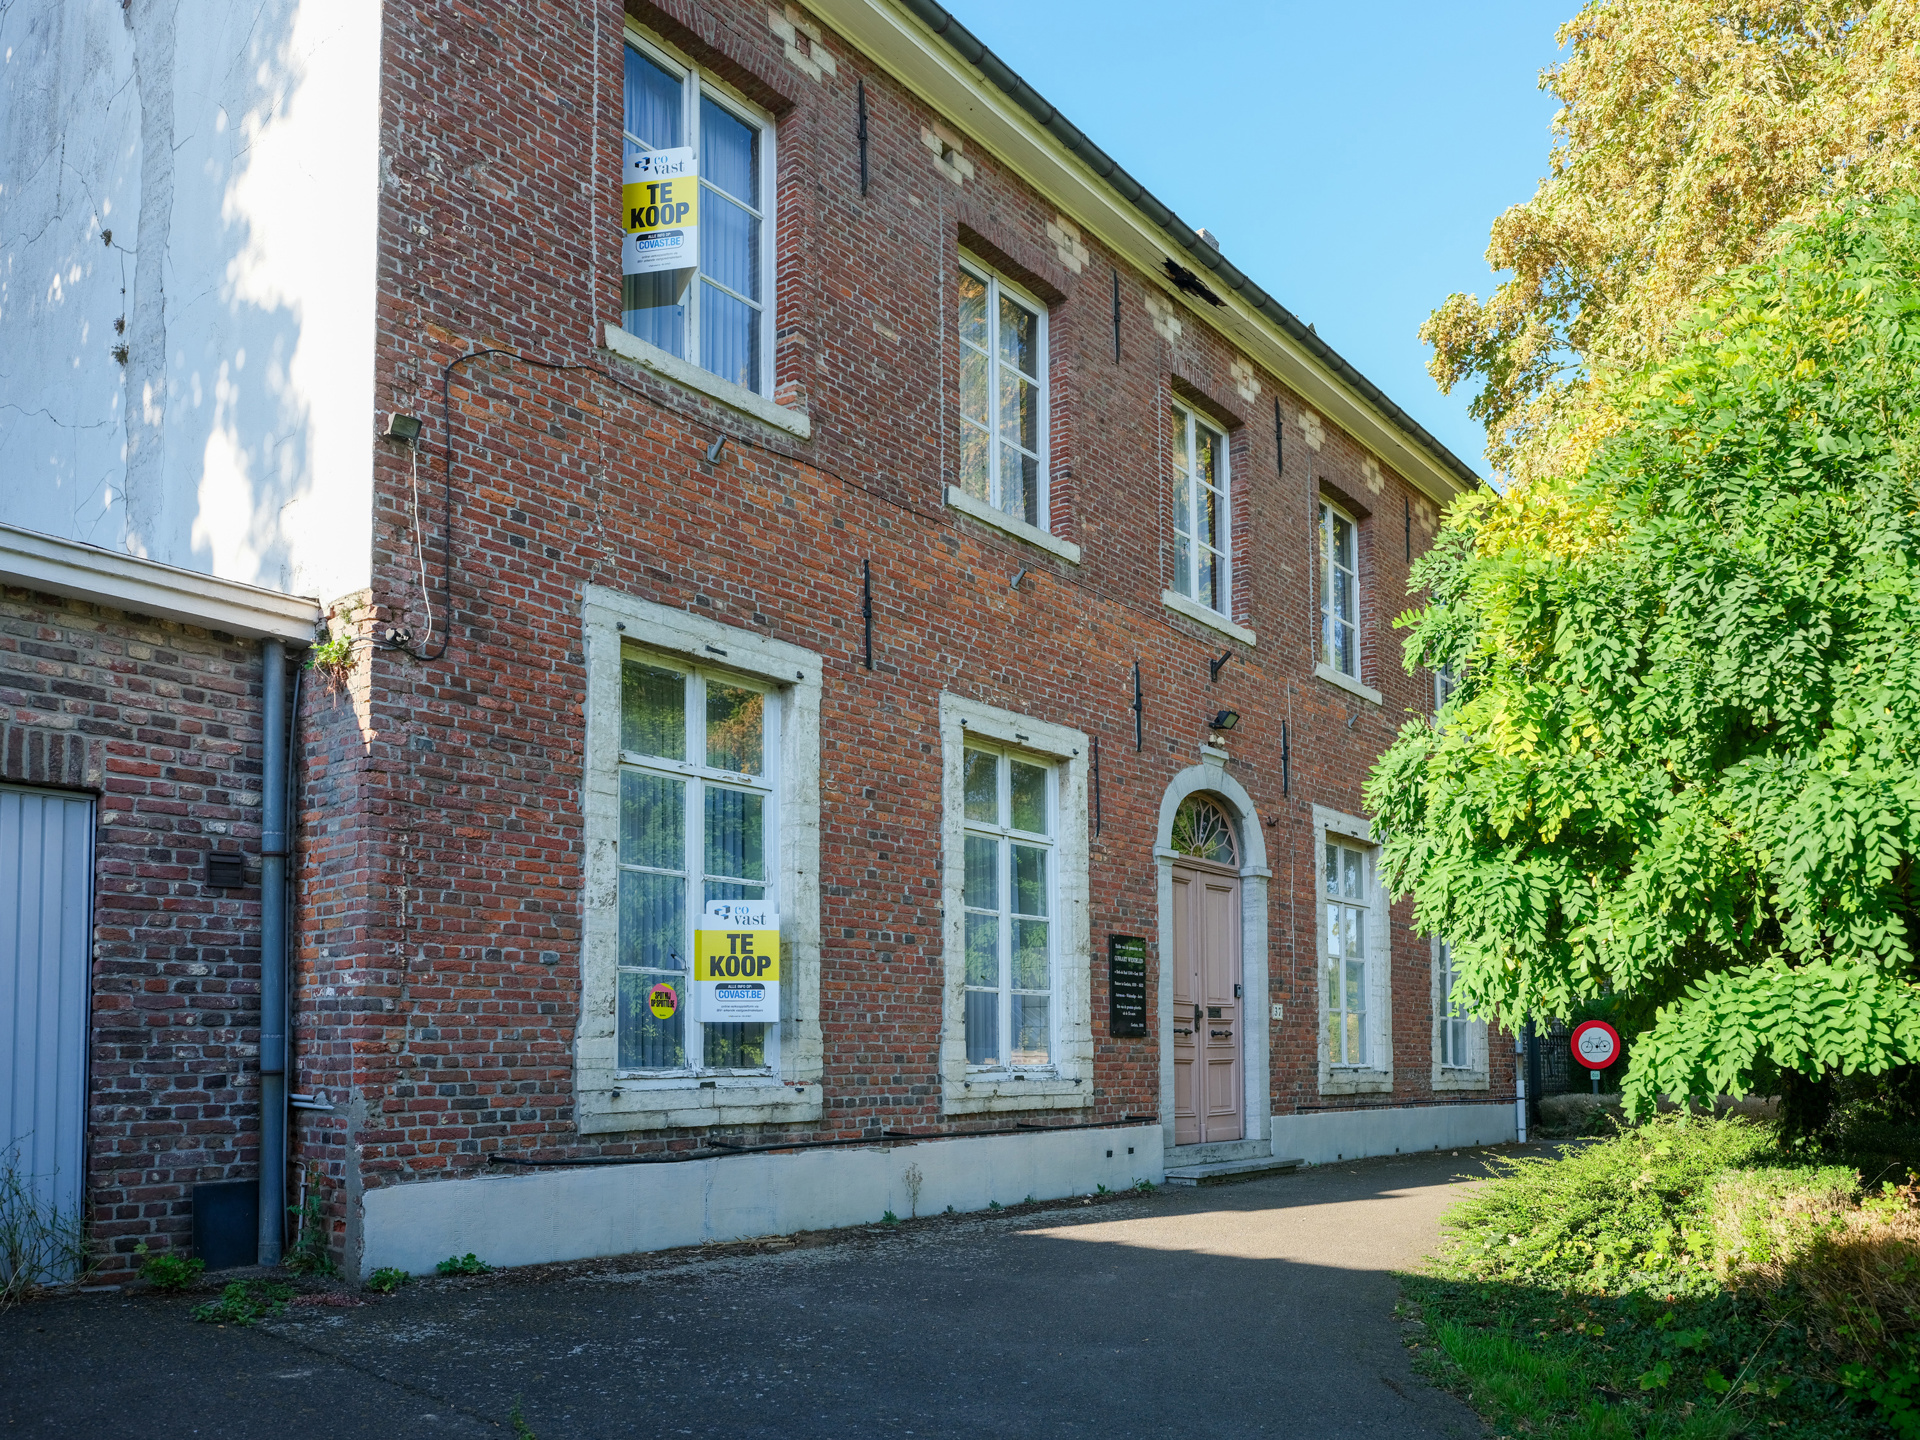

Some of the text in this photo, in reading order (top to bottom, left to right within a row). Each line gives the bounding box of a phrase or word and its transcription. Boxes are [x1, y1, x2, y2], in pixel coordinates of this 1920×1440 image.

[654, 155, 668, 165] co
[654, 159, 685, 175] vast
[646, 182, 673, 205] TE
[631, 202, 690, 229] KOOP
[639, 237, 681, 250] COVAST.BE
[735, 906, 749, 914] co
[734, 912, 766, 925] vast
[726, 934, 754, 954] TE
[710, 955, 771, 977] KOOP
[655, 991, 665, 999] SPOT
[718, 990, 762, 999] COVAST.BE
[1274, 1006, 1282, 1017] 37
